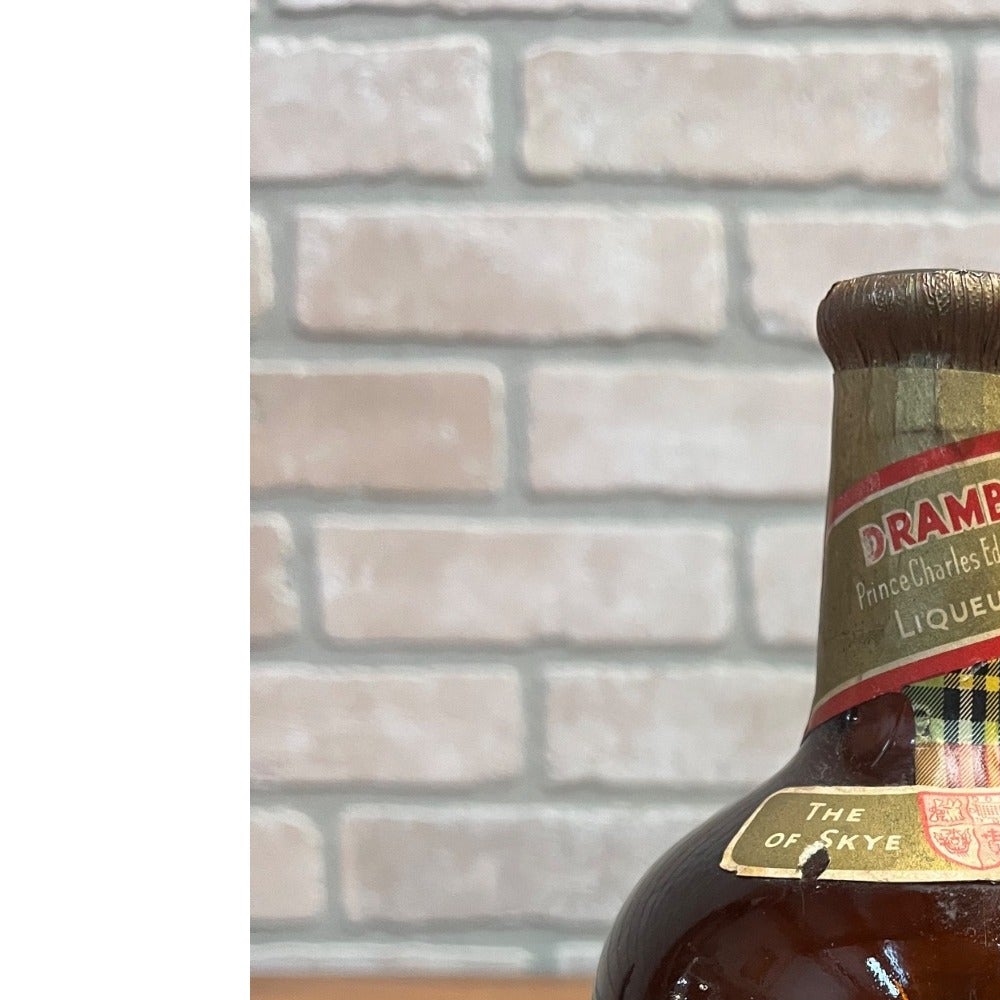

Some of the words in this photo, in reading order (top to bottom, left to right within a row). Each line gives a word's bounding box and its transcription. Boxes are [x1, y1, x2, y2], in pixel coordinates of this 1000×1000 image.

[856, 576, 910, 610] Prince
[909, 546, 980, 588] Charles
[806, 802, 865, 822] THE
[765, 832, 801, 848] OF
[820, 829, 902, 850] SKYE
